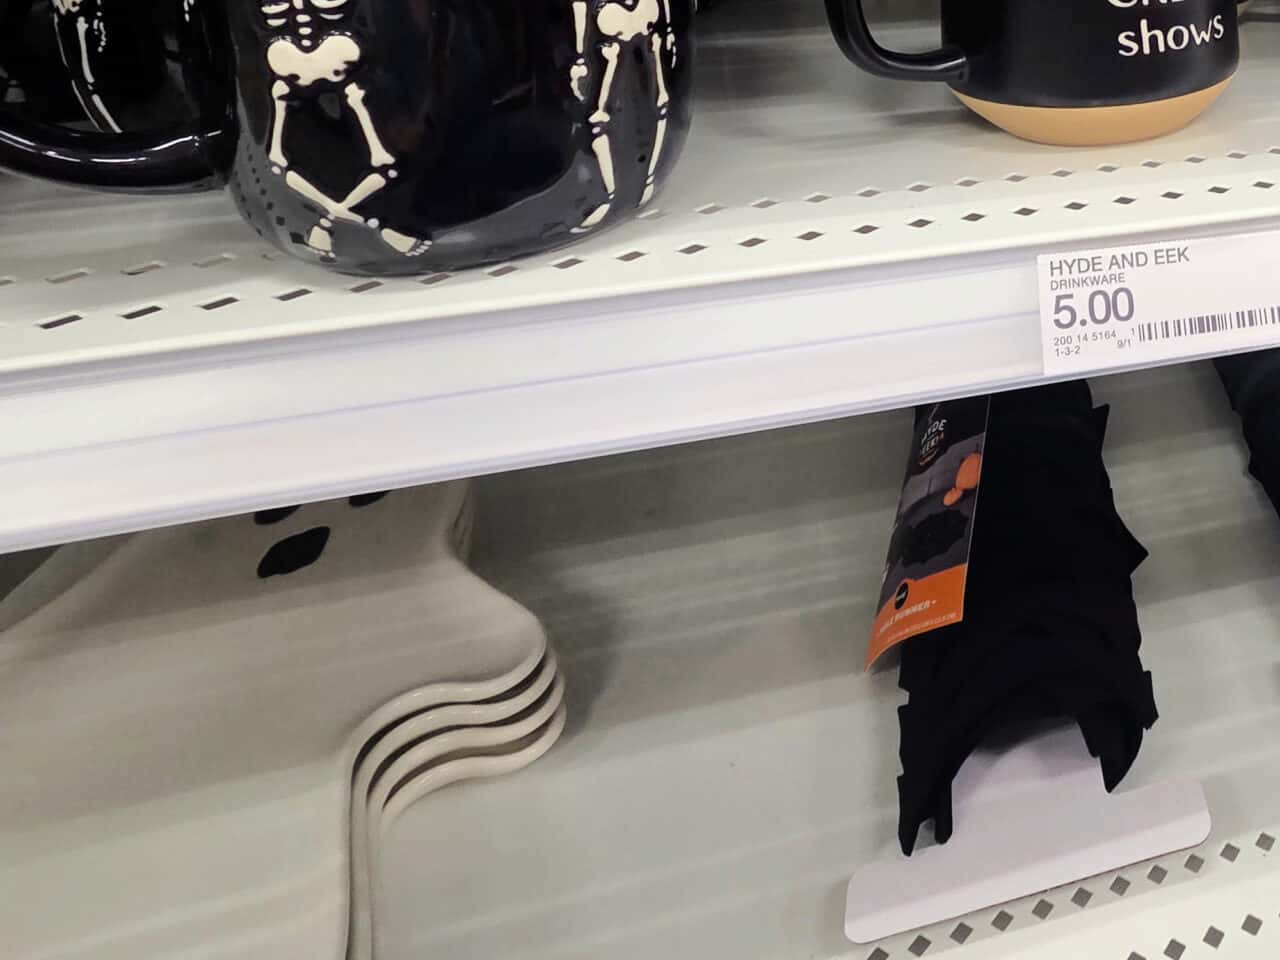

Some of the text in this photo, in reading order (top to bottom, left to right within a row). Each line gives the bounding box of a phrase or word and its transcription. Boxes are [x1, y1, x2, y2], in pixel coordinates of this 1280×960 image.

[1117, 15, 1225, 57] shows
[1050, 246, 1190, 278] HYDE AND EEK
[1050, 273, 1126, 291] DRINKWARE
[1053, 287, 1135, 330] 5.00
[1054, 335, 1073, 347] 200
[1077, 333, 1089, 343] 14
[1092, 329, 1117, 341] 5164
[1055, 344, 1081, 358] 1-3-2
